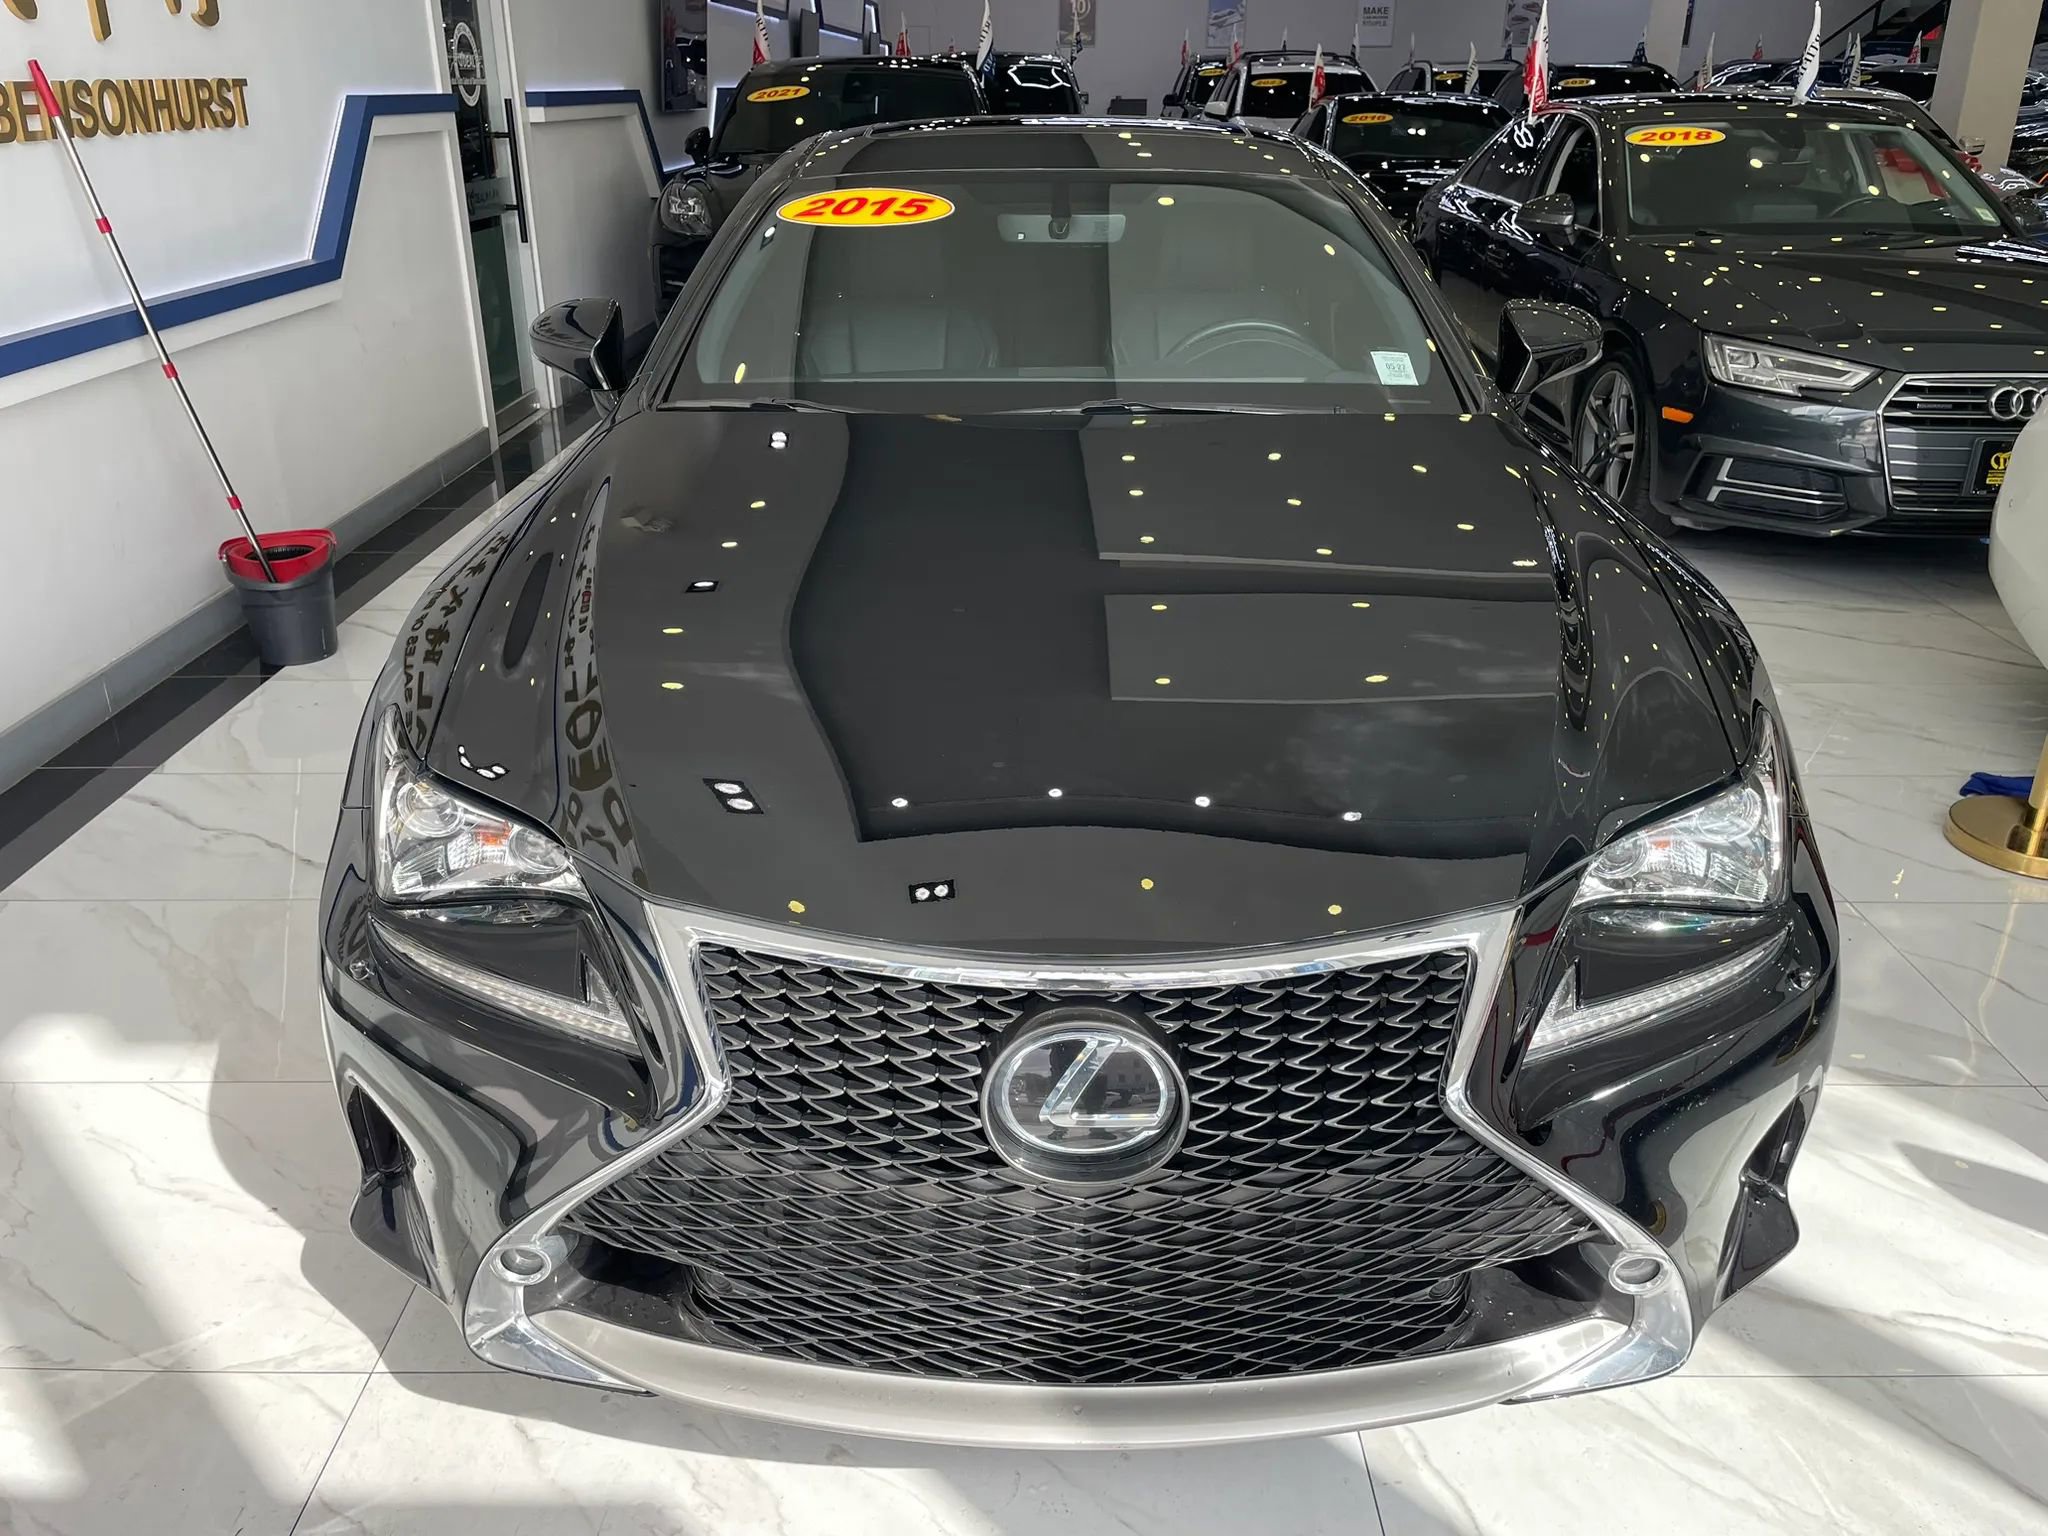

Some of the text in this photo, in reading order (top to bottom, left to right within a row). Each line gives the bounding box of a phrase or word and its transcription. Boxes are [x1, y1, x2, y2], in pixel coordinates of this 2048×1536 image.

[1363, 6, 1389, 15] MAKE
[754, 87, 802, 100] 2021
[1639, 131, 1712, 142] 2018
[793, 197, 936, 218] 2015
